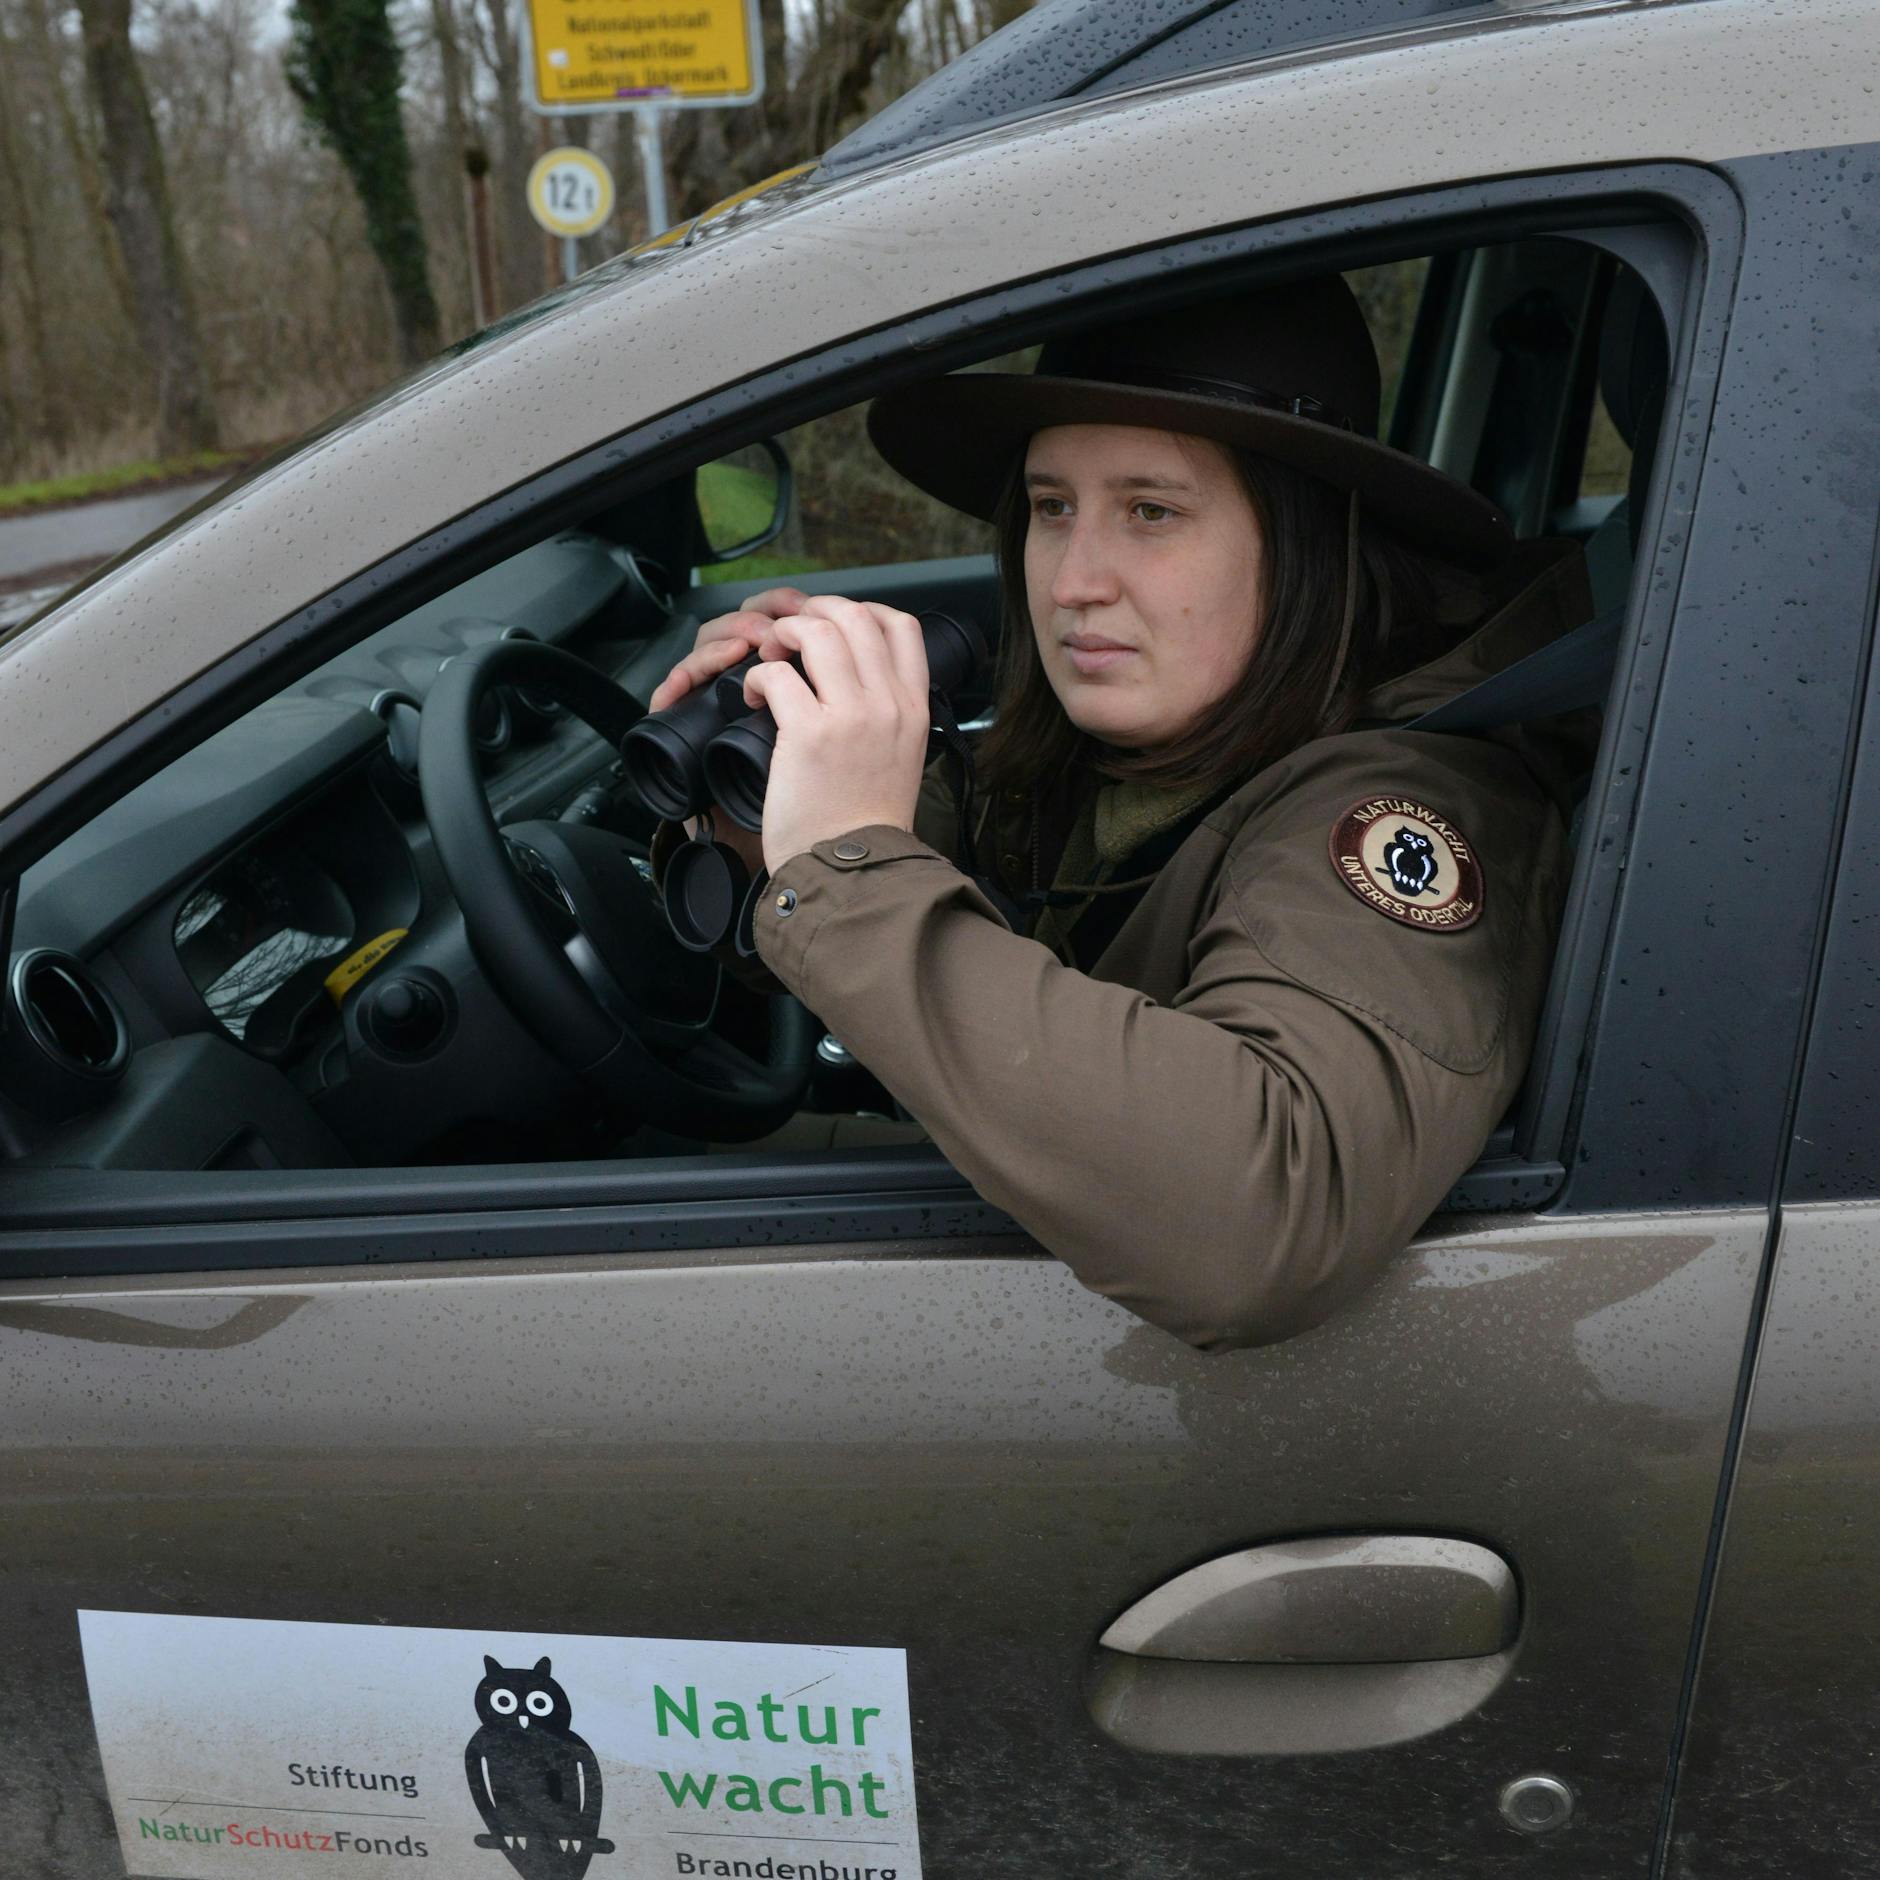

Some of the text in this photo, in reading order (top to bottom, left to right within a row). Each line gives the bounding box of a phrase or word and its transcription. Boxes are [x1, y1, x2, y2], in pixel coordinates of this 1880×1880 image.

[567, 11, 711, 34] Nationalparkstadt
[547, 173, 578, 211] 12
[1353, 800, 1471, 864] NATURWACHT
[1341, 855, 1474, 925] UNTERES ODERTAL
[653, 1684, 881, 1746] Natur
[288, 1763, 419, 1798] Stiftung
[657, 1764, 889, 1819] wacht
[138, 1817, 429, 1858] NaturSchutzFonds
[675, 1852, 897, 1880] Brandenburg
